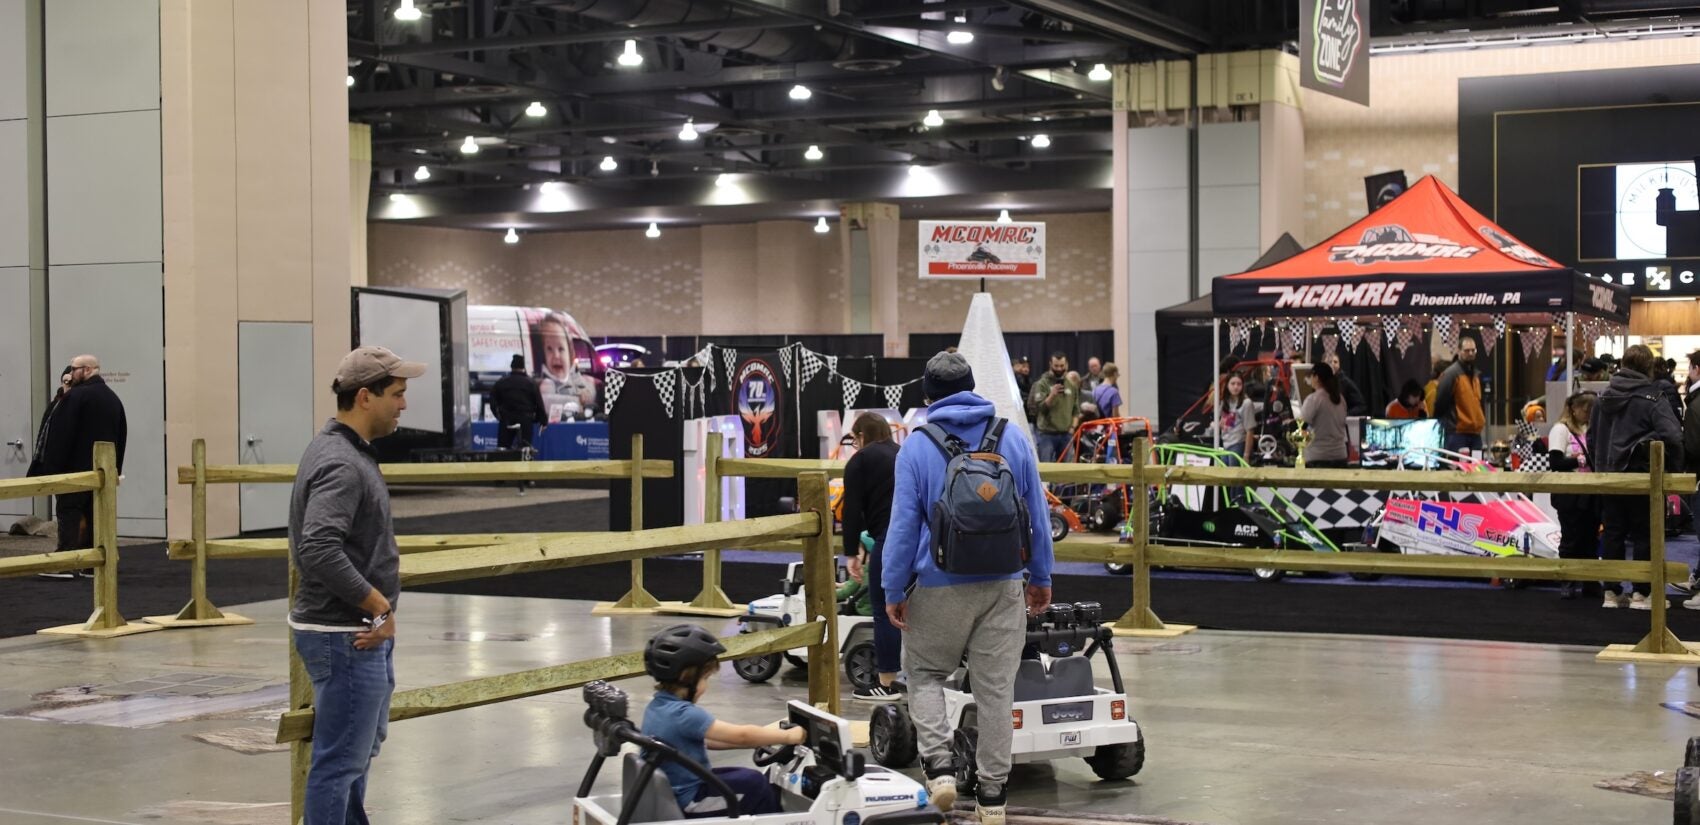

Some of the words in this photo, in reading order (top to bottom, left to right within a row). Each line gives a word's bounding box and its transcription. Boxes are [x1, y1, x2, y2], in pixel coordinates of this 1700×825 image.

[1319, 33, 1342, 71] ZONE
[931, 225, 1036, 244] MCQMRC
[1331, 242, 1480, 259] MCQMRC
[947, 262, 986, 271] Phoenixville
[987, 262, 1018, 272] Raceway
[1258, 282, 1406, 310] MCQMRC
[1410, 293, 1497, 306] Phoenixville,
[1502, 292, 1521, 304] PA
[1234, 524, 1259, 534] ACP
[1496, 533, 1520, 549] FUEL
